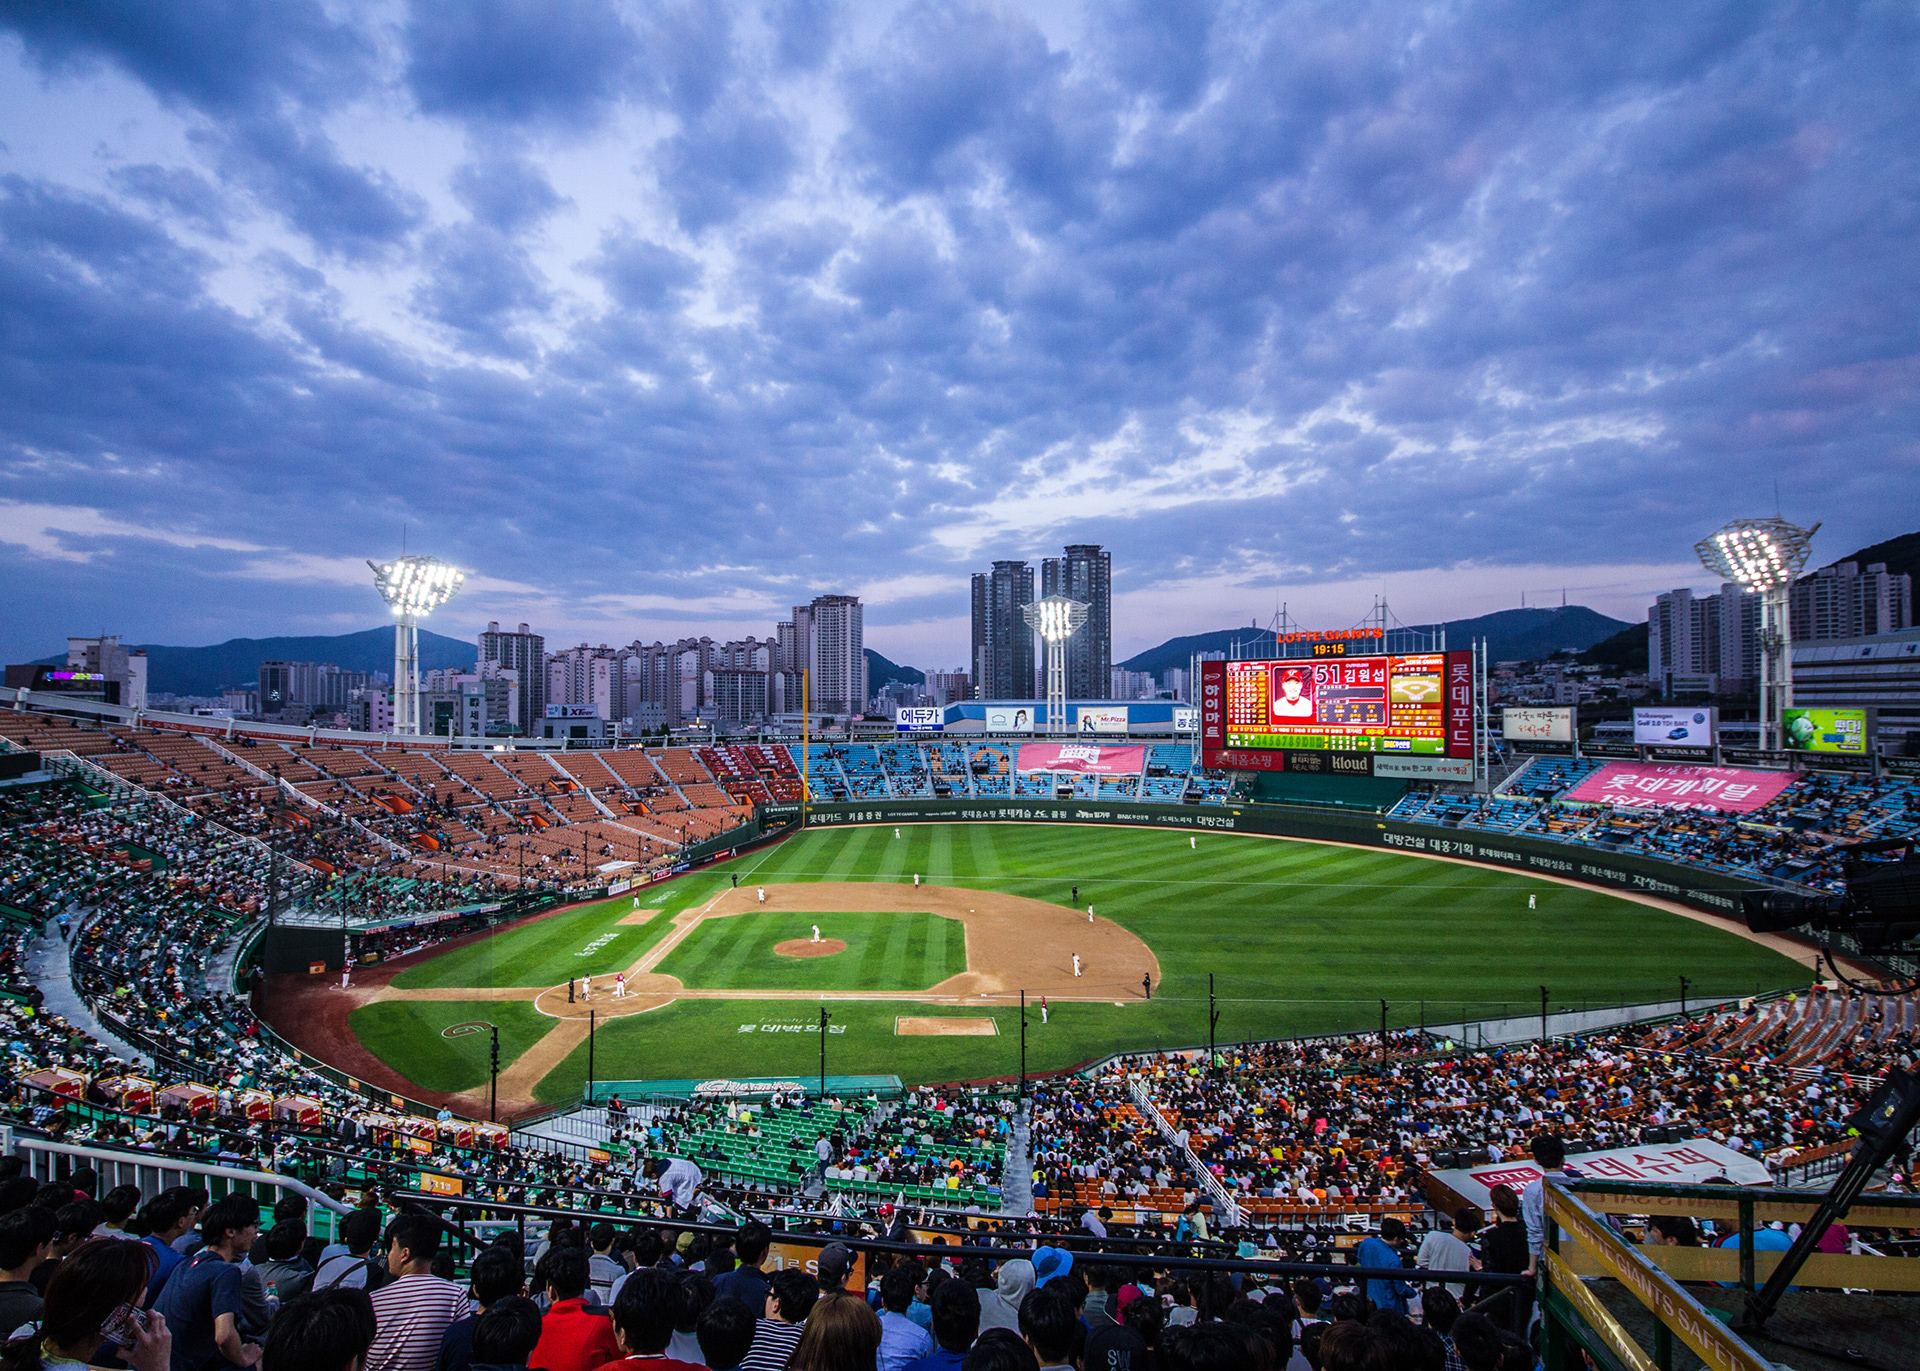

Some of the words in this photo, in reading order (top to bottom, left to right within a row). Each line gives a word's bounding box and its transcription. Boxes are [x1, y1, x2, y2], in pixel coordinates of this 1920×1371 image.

[1277, 631, 1322, 644] LOTTE
[1324, 627, 1384, 641] GIANTS
[1313, 643, 1345, 655] 19:15
[1315, 664, 1340, 684] 51
[1344, 668, 1385, 683] 김원섭
[1204, 683, 1220, 738] 하이마트
[1451, 662, 1471, 747] 롯데푸드
[570, 708, 594, 716] XTeer
[901, 709, 939, 723] 에듀카
[1637, 712, 1673, 720] Volkswagen
[1834, 719, 1862, 734] 떴다!
[1214, 751, 1272, 768] 롯데홈쇼핑
[1602, 774, 1759, 801] 롯데캐피탈
[809, 812, 842, 824] 롯데카드
[848, 811, 882, 821] 키움증권
[961, 810, 997, 819] 롯데홈쇼핑
[998, 808, 1032, 819] 롯데캐슬
[1051, 810, 1068, 819] 콜핑
[1161, 815, 1193, 824] 도미노피자
[1196, 815, 1235, 828] 대방건설
[1383, 832, 1426, 849] 대방건설
[1429, 838, 1474, 856] 대홍기획
[1479, 847, 1522, 862] 롯데워터파크
[1529, 855, 1573, 871] 롯데칠성음료
[1580, 864, 1627, 882] 롯데손해보험
[573, 889, 599, 897] EXCITING
[694, 1079, 808, 1092] Giants
[1479, 1169, 1537, 1183] LOTTE
[1572, 1213, 1614, 1263] LOTTE
[1615, 1253, 1675, 1317] GIANTS
[1107, 1349, 1132, 1368] SW
